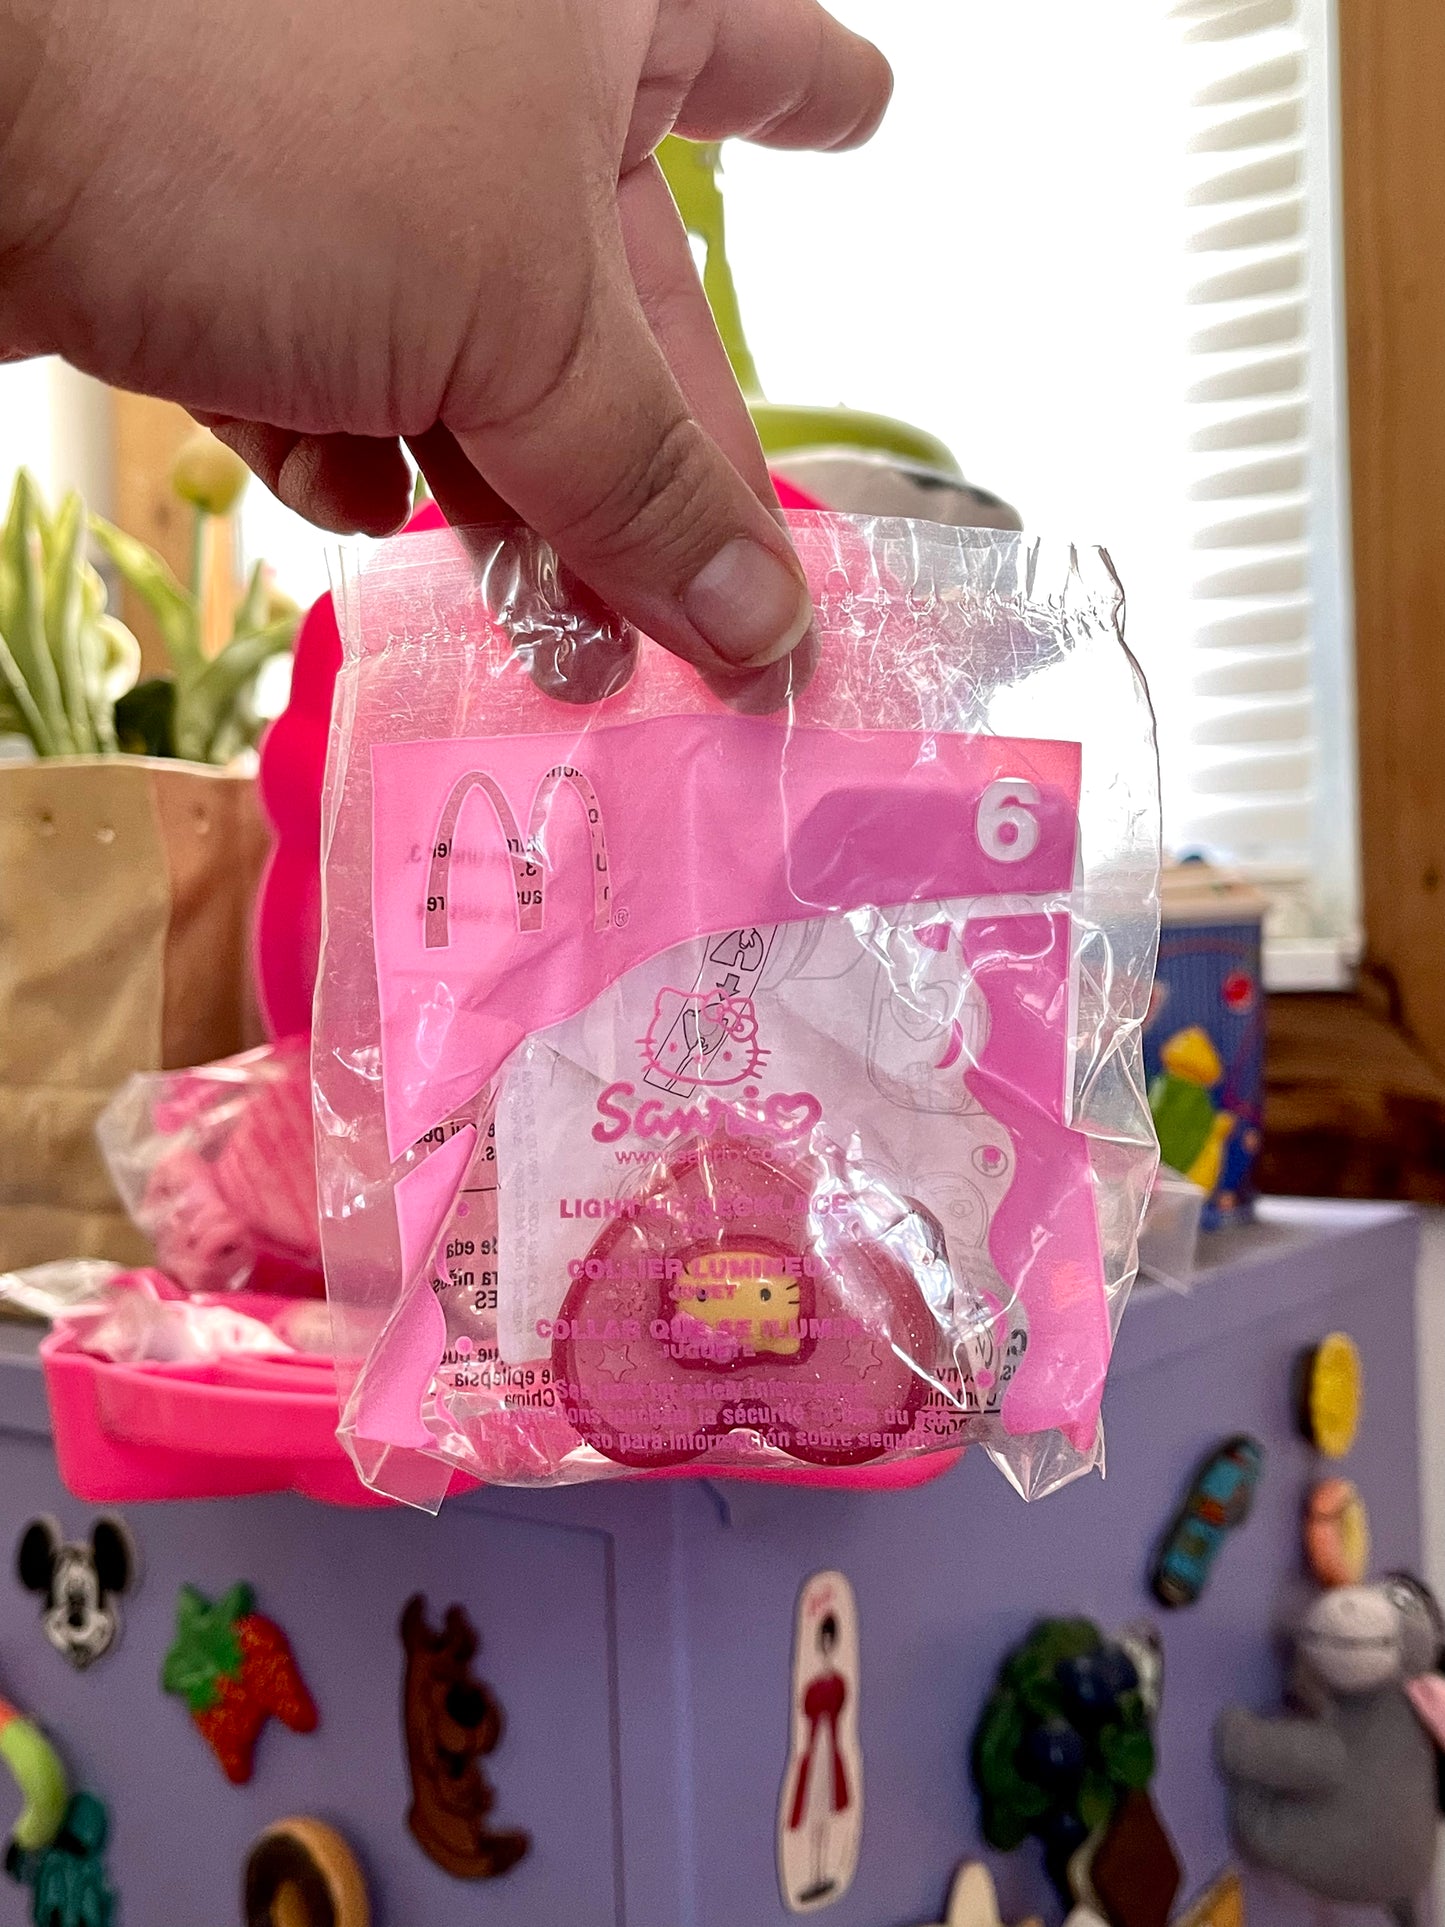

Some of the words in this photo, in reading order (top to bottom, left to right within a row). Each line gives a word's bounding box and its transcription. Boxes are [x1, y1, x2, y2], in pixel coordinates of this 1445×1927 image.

[976, 776, 1040, 863] 6
[567, 1257, 683, 1280] COLLIER
[693, 1256, 842, 1279] LUMINEUX
[535, 1318, 642, 1341] COLLAR
[619, 1433, 665, 1454] para
